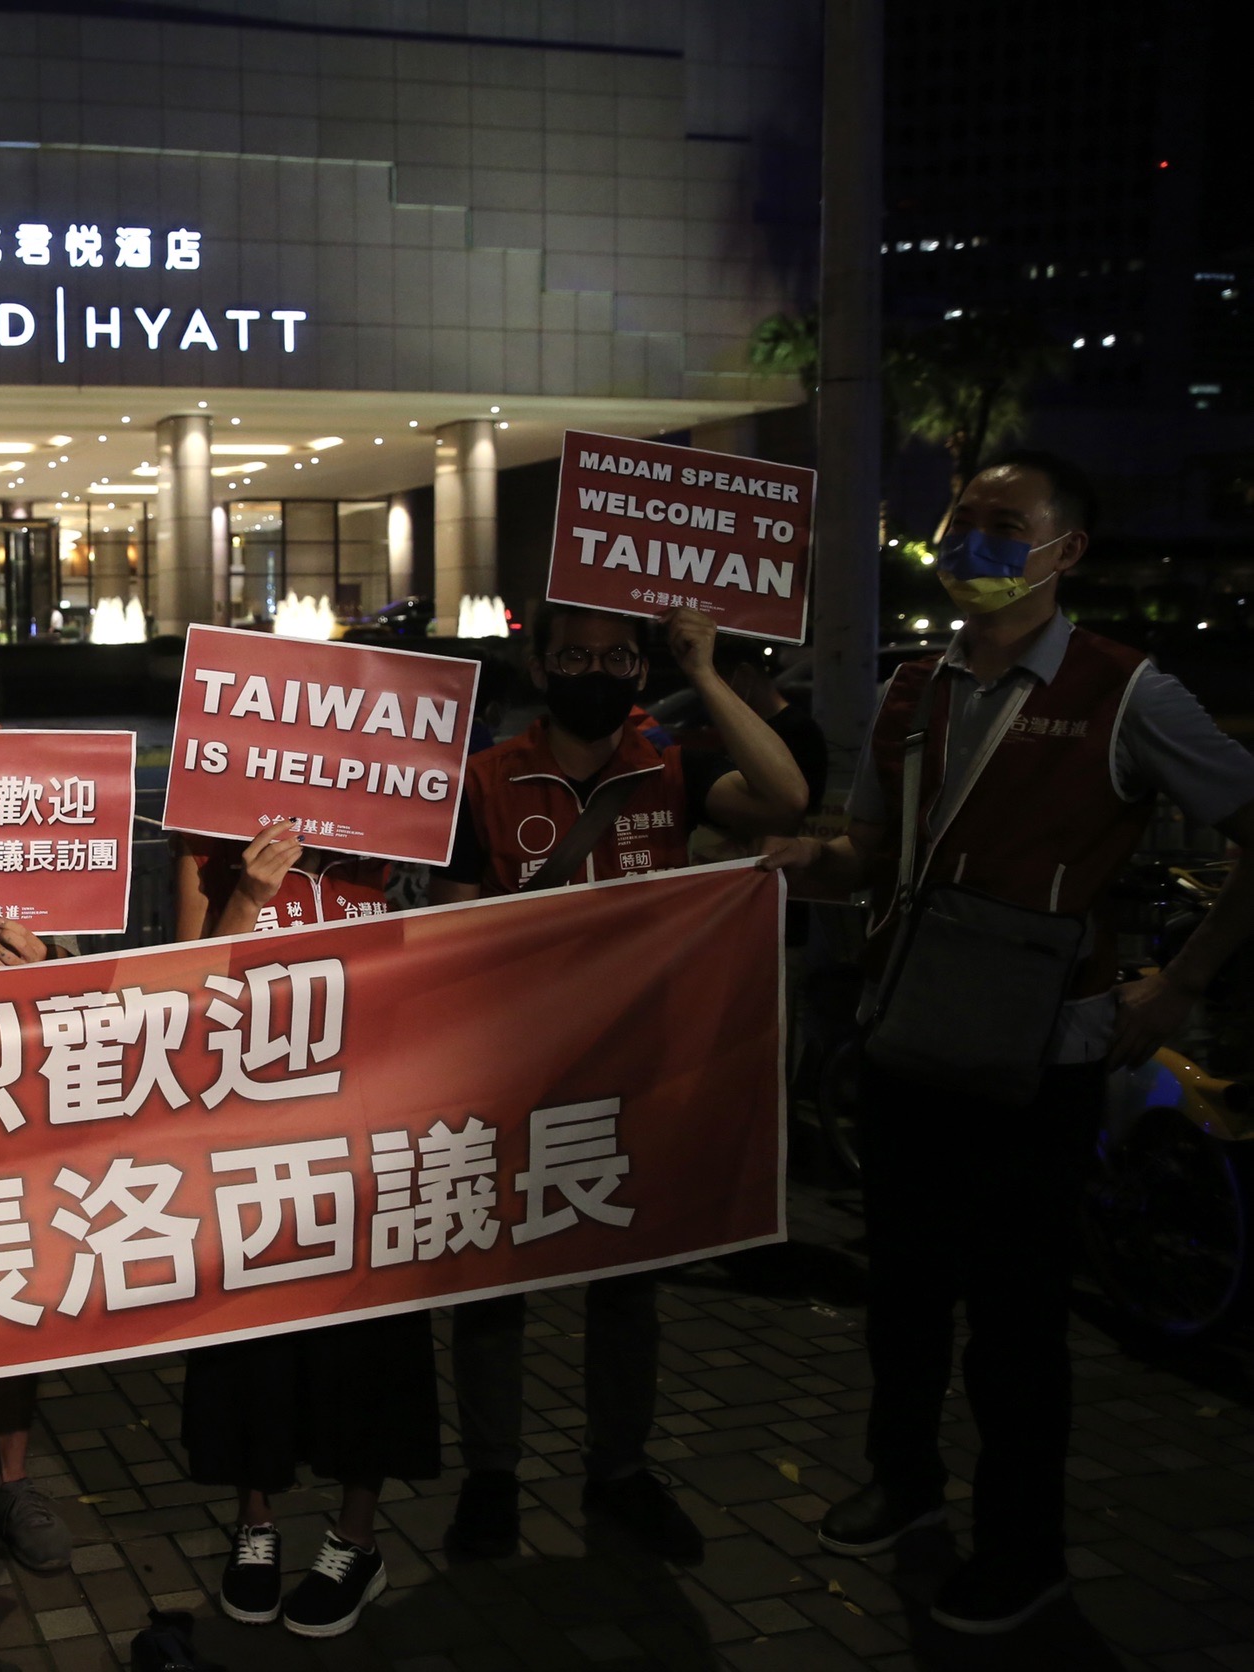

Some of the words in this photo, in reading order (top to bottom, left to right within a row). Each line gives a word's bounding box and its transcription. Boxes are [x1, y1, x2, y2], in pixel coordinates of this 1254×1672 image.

[85, 306, 308, 353] HYATT
[578, 450, 673, 483] MADAM
[680, 467, 799, 503] SPEAKER
[578, 487, 736, 534] WELCOME
[753, 516, 795, 544] TO
[572, 526, 795, 599] TAIWAN
[194, 668, 459, 744] TAIWAN
[184, 738, 229, 774] IS
[245, 745, 449, 802] HELPING
